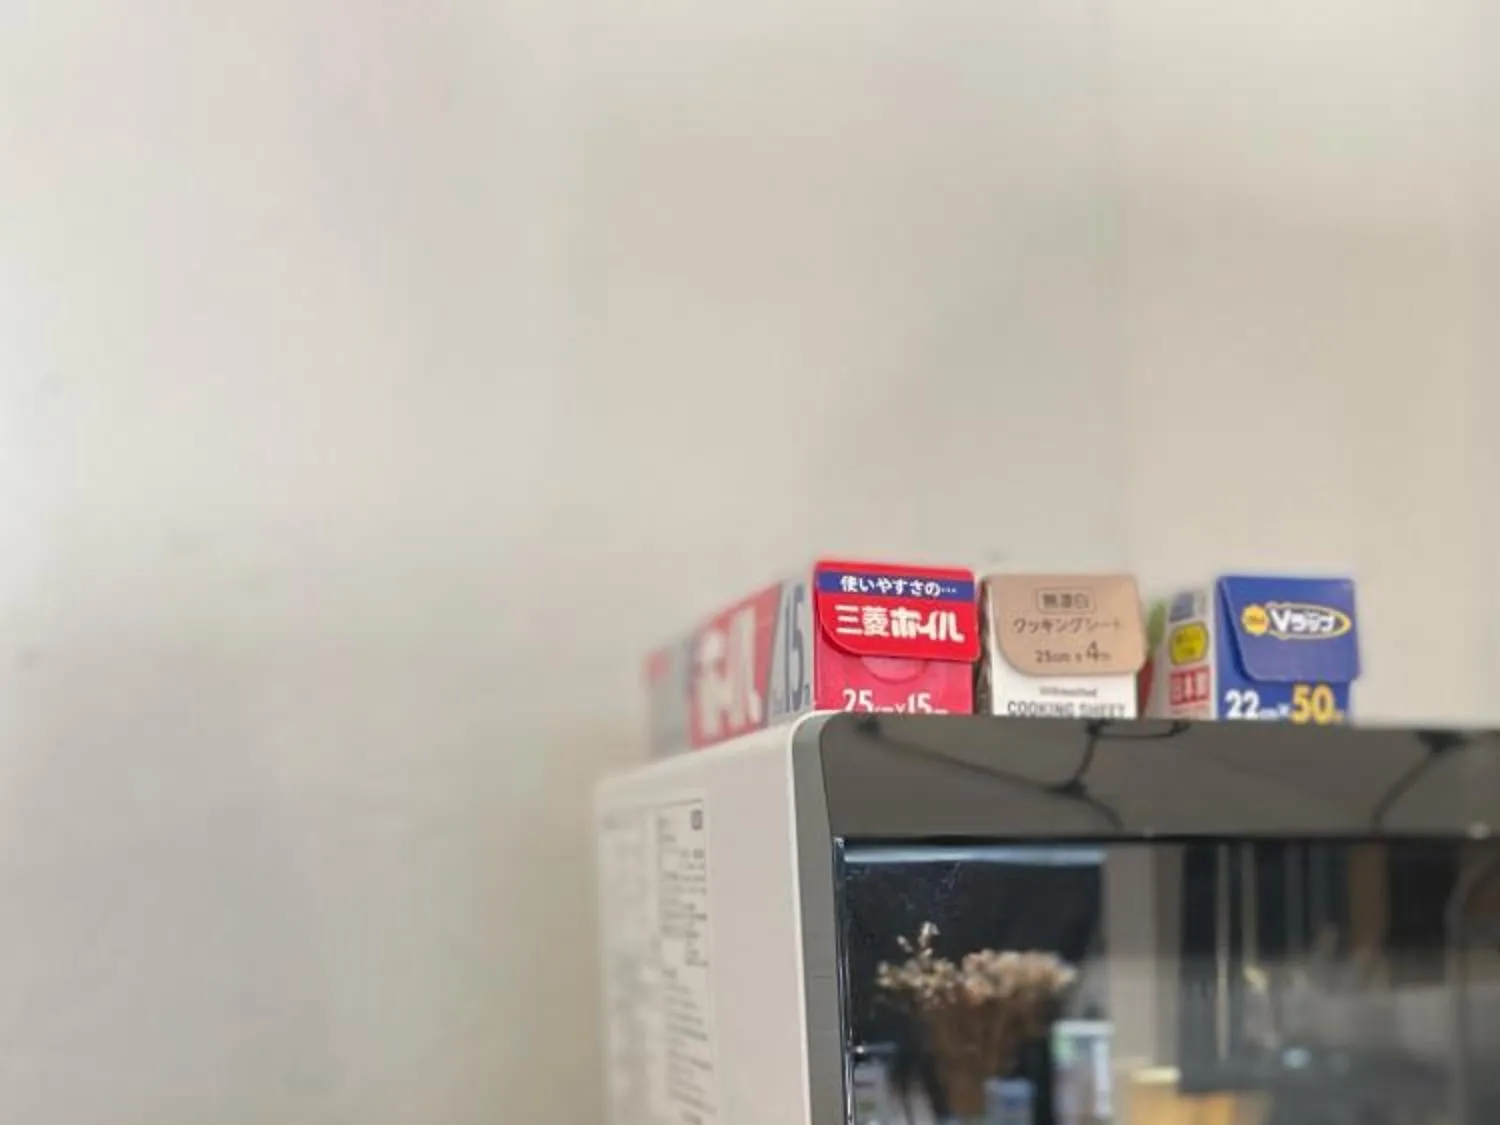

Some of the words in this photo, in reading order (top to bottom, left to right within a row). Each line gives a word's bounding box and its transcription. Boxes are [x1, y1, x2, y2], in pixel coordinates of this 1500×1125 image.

[834, 604, 965, 643] 三菱ホイル
[1013, 617, 1120, 634] クッキングシート
